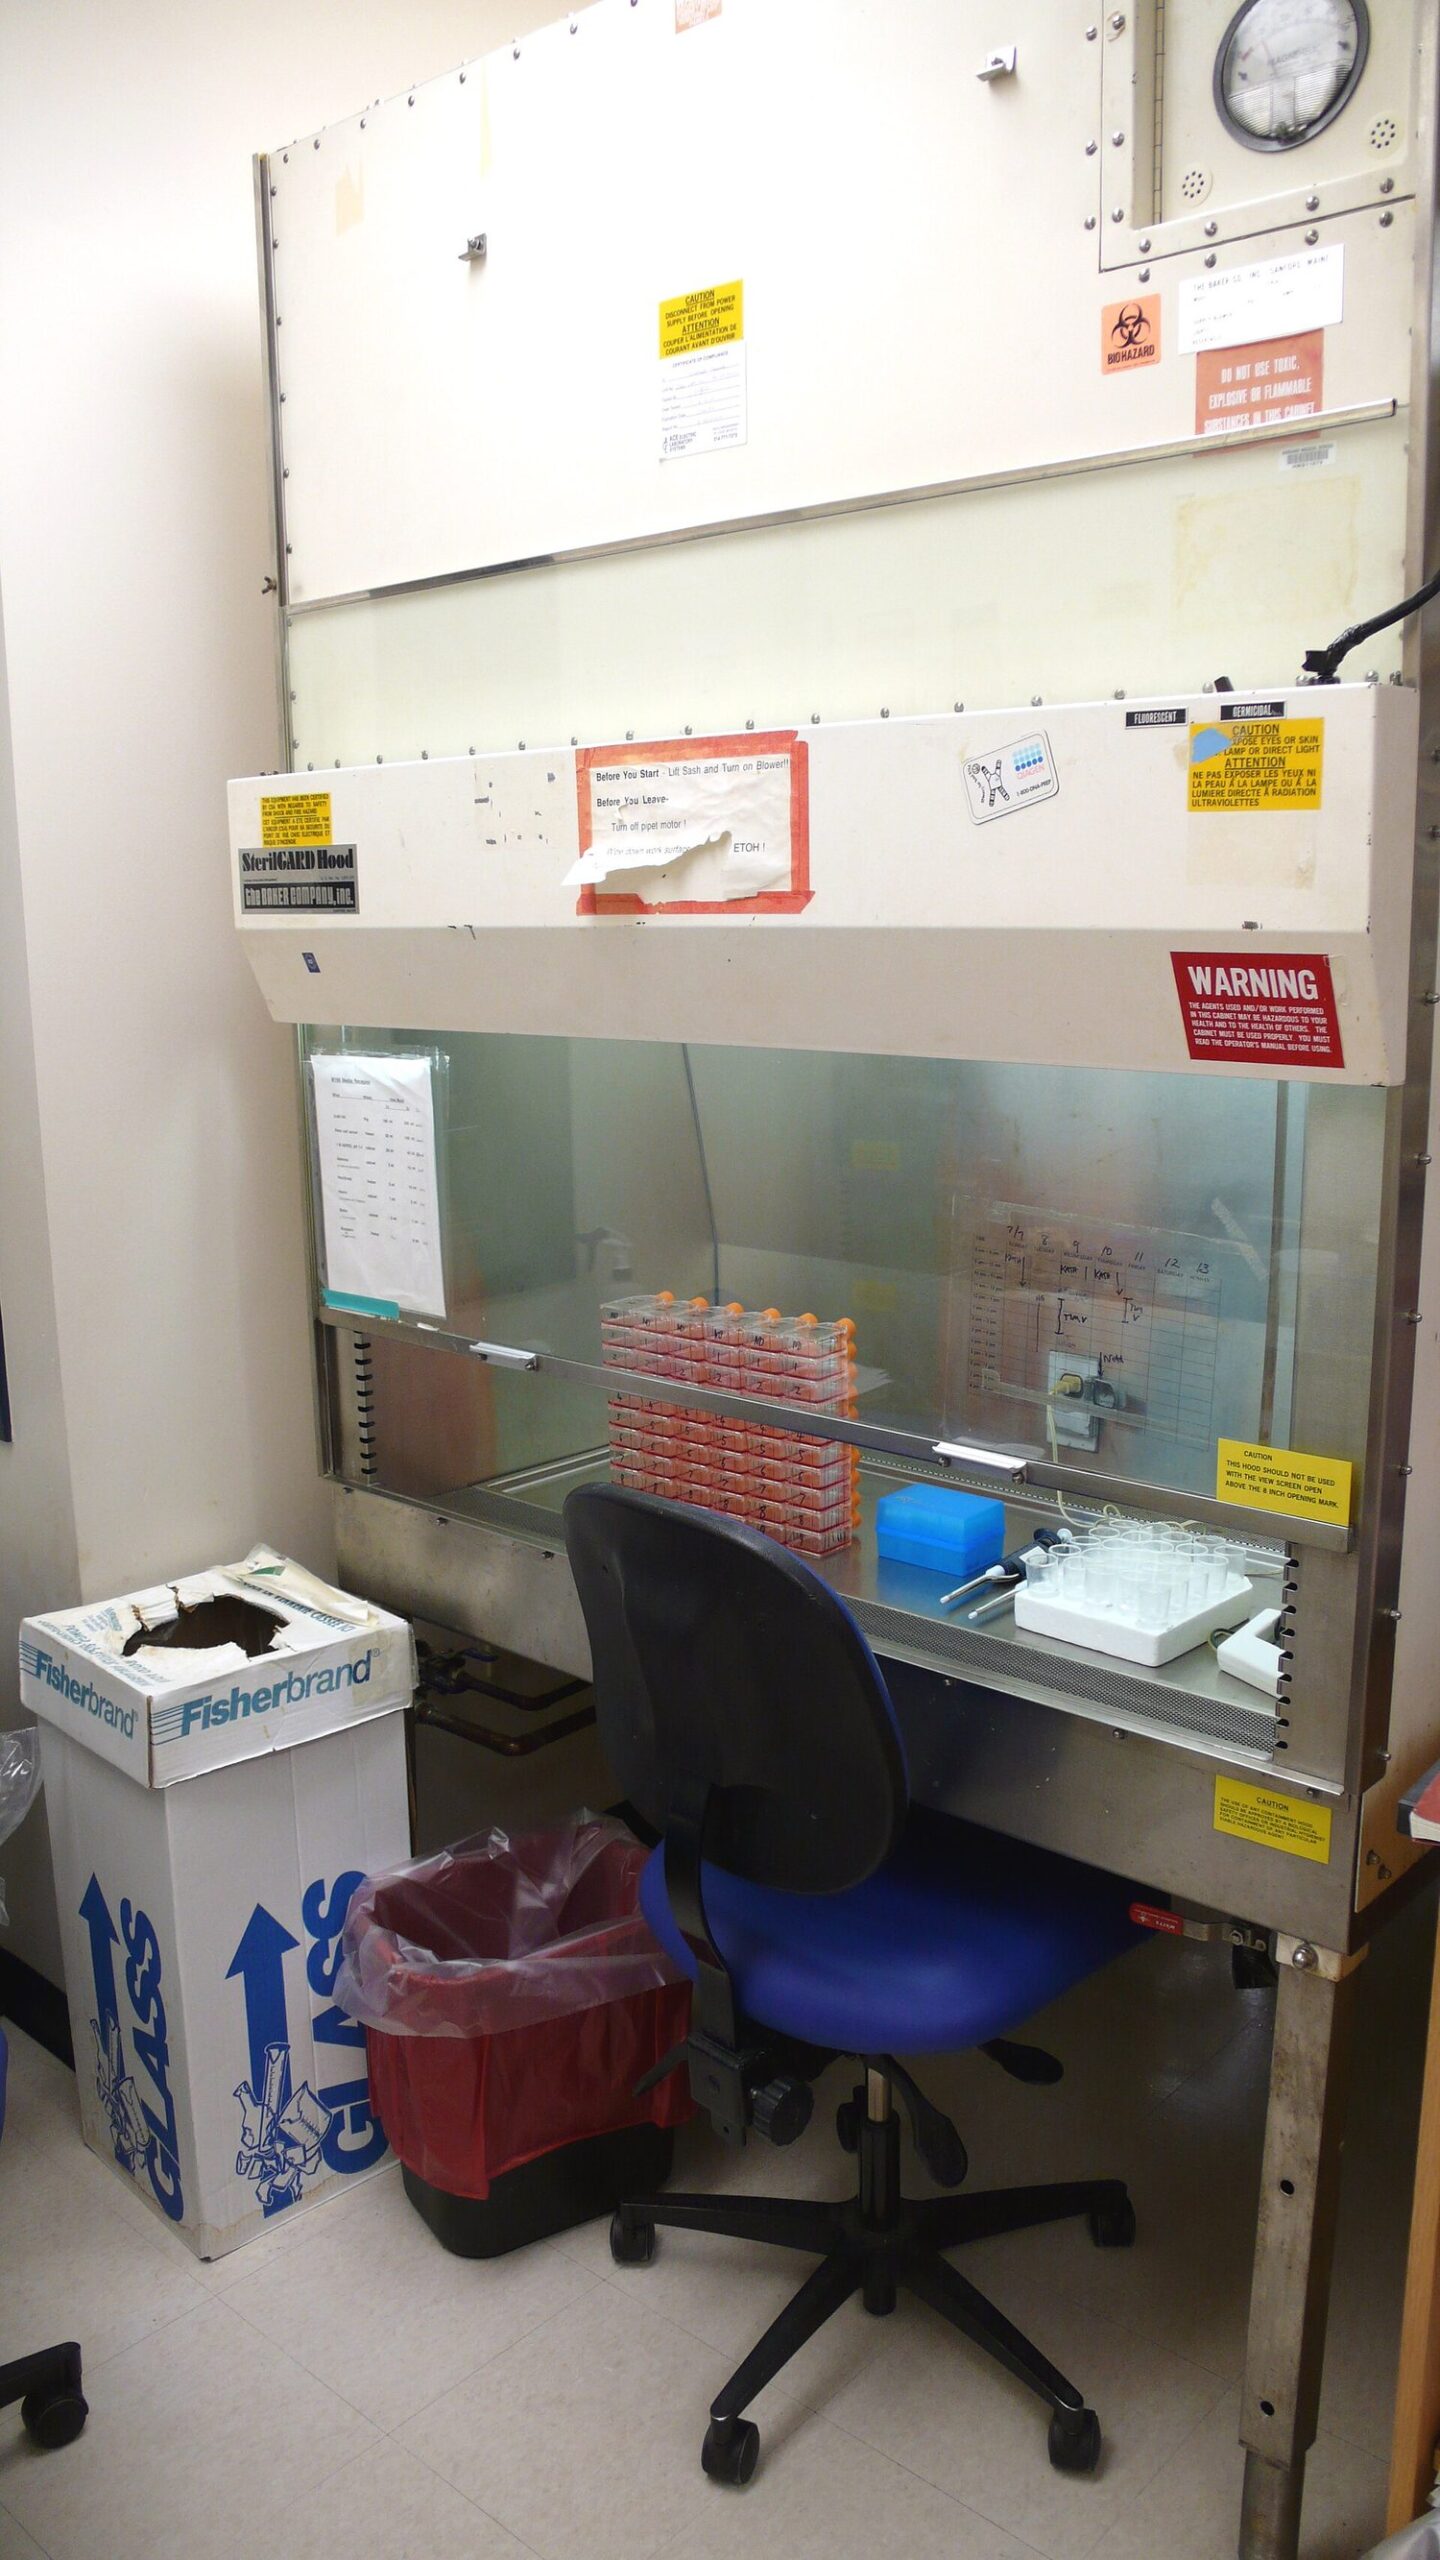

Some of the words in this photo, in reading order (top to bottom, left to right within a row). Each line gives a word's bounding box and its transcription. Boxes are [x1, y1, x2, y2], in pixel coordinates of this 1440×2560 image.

[685, 289, 715, 305] CAUTION
[665, 304, 697, 320] DISCONNECT
[700, 300, 715, 310] FROM
[717, 294, 736, 306] POWER
[667, 316, 686, 328] SUPPLY
[688, 310, 707, 322] BEFORE
[711, 303, 734, 316] OPENING
[682, 316, 719, 334] ATTENTION
[663, 337, 684, 348] COUPER
[685, 326, 729, 342] L'ALIMENTATION
[730, 323, 737, 331] DE
[666, 344, 689, 356] COURANT
[692, 339, 709, 349] AVANT
[1107, 345, 1155, 365] BIOHAZARD
[1221, 368, 1233, 384] DO
[1235, 365, 1251, 381] NOT
[1255, 362, 1270, 378] USE
[1209, 389, 1248, 410] EXPLOSIVE
[1250, 387, 1261, 403] OR
[1264, 377, 1312, 401] FLAMMABLE
[1134, 711, 1177, 725] FLUORESCENT
[1232, 704, 1273, 718] GERMICIDAL
[1232, 724, 1280, 736] CAUTION
[1261, 736, 1281, 745] EYES
[1285, 736, 1296, 744] OR
[1299, 735, 1318, 744] SKIN
[1224, 748, 1245, 756] LAMP
[1248, 747, 1260, 755] OR
[1263, 746, 1293, 755] DIRECT
[1295, 744, 1320, 753] LIGHT
[1225, 757, 1286, 768] ATTENTION
[596, 772, 620, 782] Before
[623, 770, 637, 780] You
[640, 769, 659, 778] Start
[668, 767, 680, 776] Lift
[682, 766, 701, 776] Sash
[704, 764, 718, 774] and
[722, 763, 739, 772] Turn
[743, 763, 753, 771] on
[756, 758, 789, 770] Blower!!
[1193, 771, 1203, 779] NE
[1206, 771, 1221, 779] PAS
[1224, 770, 1261, 779] EXPOSER
[1264, 770, 1278, 778] LES
[1282, 769, 1303, 778] YEUX
[1307, 769, 1316, 777] NI
[1193, 780, 1202, 788] LA
[1205, 780, 1226, 788] PEAU
[1237, 780, 1247, 788] LA
[1251, 779, 1277, 787] LAMPE
[1280, 778, 1293, 787] OU
[1306, 778, 1316, 786] LA
[1192, 789, 1225, 797] LUMIERE
[1227, 788, 1261, 797] DIRECTE
[1272, 787, 1316, 796] RADIATION
[596, 797, 620, 807] Before
[624, 797, 638, 806] You
[1192, 798, 1259, 807] ULTRAVIOLETTES
[611, 822, 627, 831] Turn
[629, 822, 638, 831] off
[641, 821, 659, 832] pipet
[660, 820, 681, 830] motor
[733, 842, 760, 852] ETOH
[317, 848, 354, 869] Hood
[1187, 966, 1319, 1000] WARNING
[1201, 1002, 1224, 1010] AGENTS
[1225, 1003, 1241, 1011] USED
[1243, 1004, 1268, 1012] AND/OR
[1288, 1006, 1325, 1015] PERFORMED
[1213, 1012, 1237, 1020] CABINET
[1262, 1014, 1299, 1023] HAZARDOUS
[1310, 1017, 1327, 1025] YOUR
[1191, 1020, 1213, 1028] HEALTH
[1251, 1023, 1274, 1031] HEALTH
[1316, 1026, 1327, 1034] THE
[1193, 1029, 1217, 1037] CABINET
[1218, 1030, 1235, 1038] MUST
[1313, 1035, 1331, 1043] MUST
[1195, 1038, 1209, 1046] READ
[1224, 1039, 1260, 1049] OPERATOR'S
[1261, 1042, 1286, 1050] MANUAL
[1287, 1043, 1310, 1051] BEFORE
[1073, 1240, 1080, 1253] 9
[1100, 1246, 1112, 1257] 10
[1164, 1258, 1179, 1269] 12
[1197, 1263, 1209, 1274] 13
[1244, 1450, 1273, 1461] CAUTION
[1227, 1460, 1240, 1468] THIS
[1242, 1463, 1261, 1472] HOOD
[1263, 1467, 1290, 1477] SHOULD
[1291, 1472, 1305, 1481] NOT
[1307, 1475, 1316, 1483] BE
[1318, 1477, 1336, 1486] USED
[1226, 1470, 1242, 1478] WITH
[1244, 1473, 1256, 1481] THE
[1258, 1477, 1274, 1485] VIEW
[1276, 1480, 1302, 1490] SCREEN
[1304, 1485, 1322, 1494] OPEN
[1225, 1480, 1246, 1490] ABOVE
[1249, 1484, 1260, 1493] THE
[1269, 1489, 1285, 1497] INCH
[1287, 1492, 1316, 1504] OPENING
[36, 1650, 133, 1740] Fisherbrand
[181, 1649, 372, 1738] Fisherbrand
[1256, 1797, 1289, 1811] CAUTION
[120, 1897, 184, 2222] GLASS
